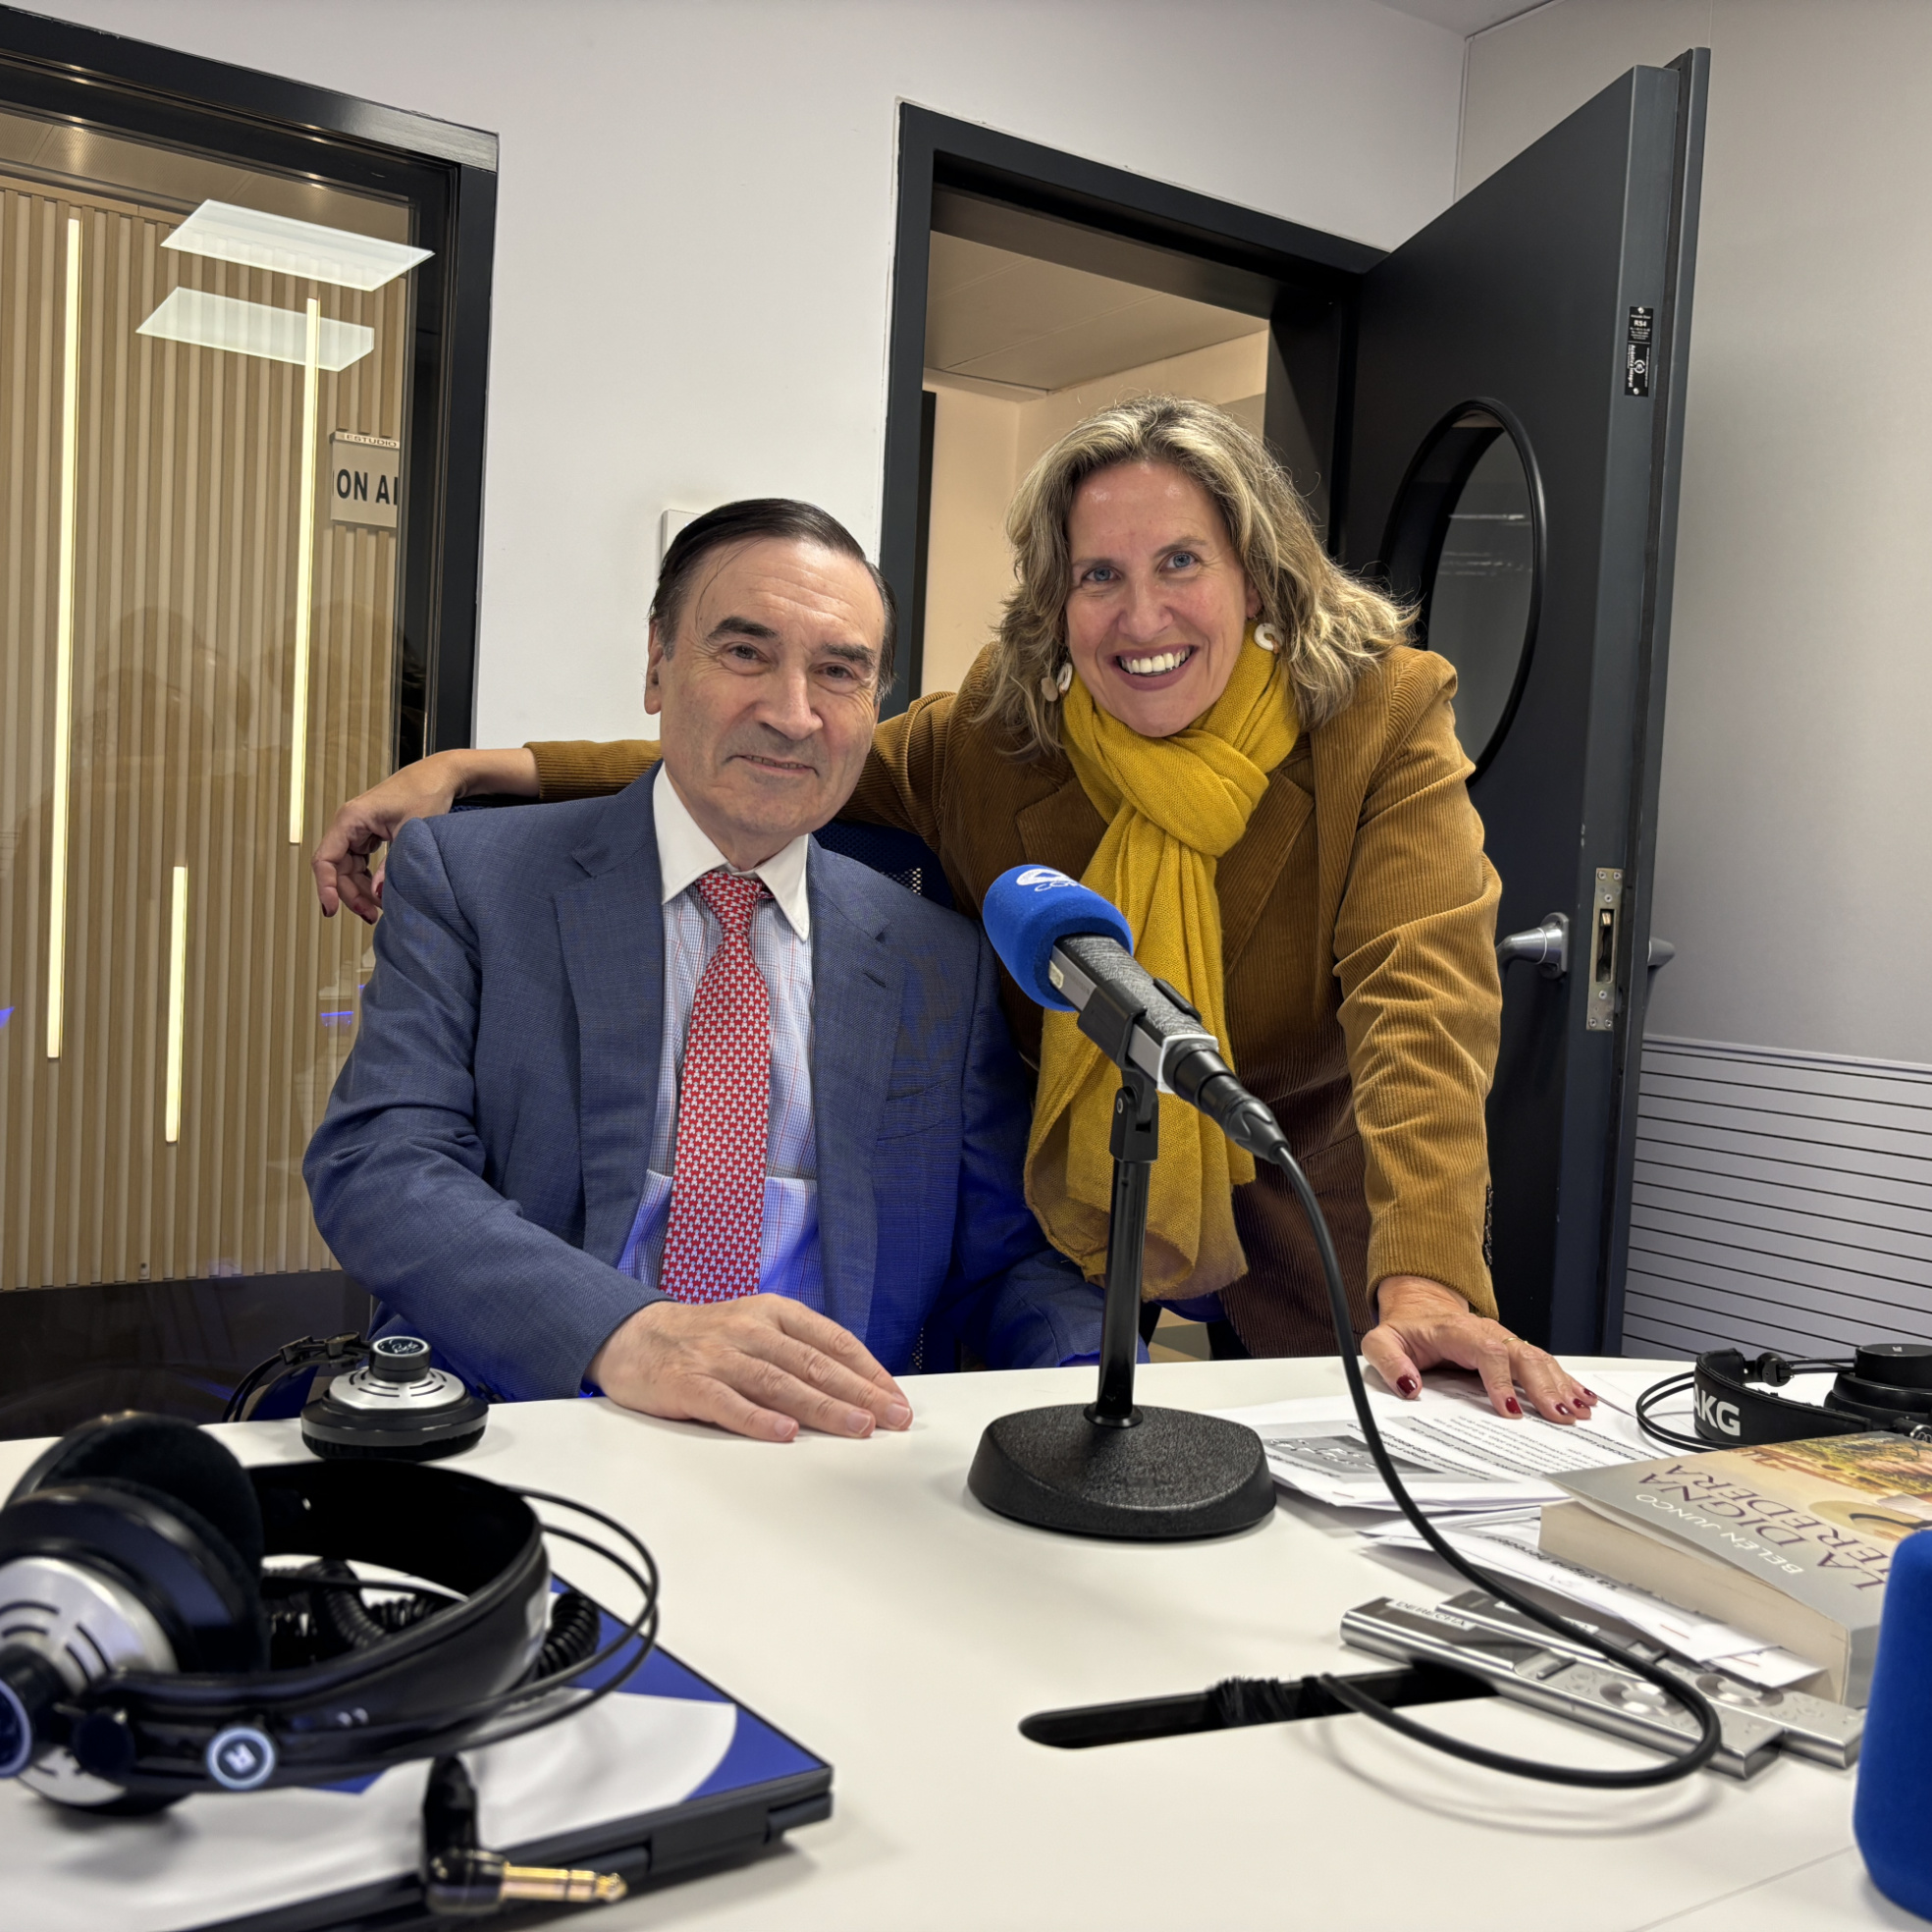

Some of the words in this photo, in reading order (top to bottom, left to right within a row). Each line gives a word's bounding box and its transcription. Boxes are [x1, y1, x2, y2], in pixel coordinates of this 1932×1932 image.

[346, 434, 397, 448] ESTUDIO
[337, 468, 368, 502] ON
[1636, 1494, 1722, 1530] JUNCO
[1638, 1473, 1809, 1547] DIGNA
[1720, 1531, 1804, 1575] BELÉN
[1816, 1550, 1886, 1590] LA
